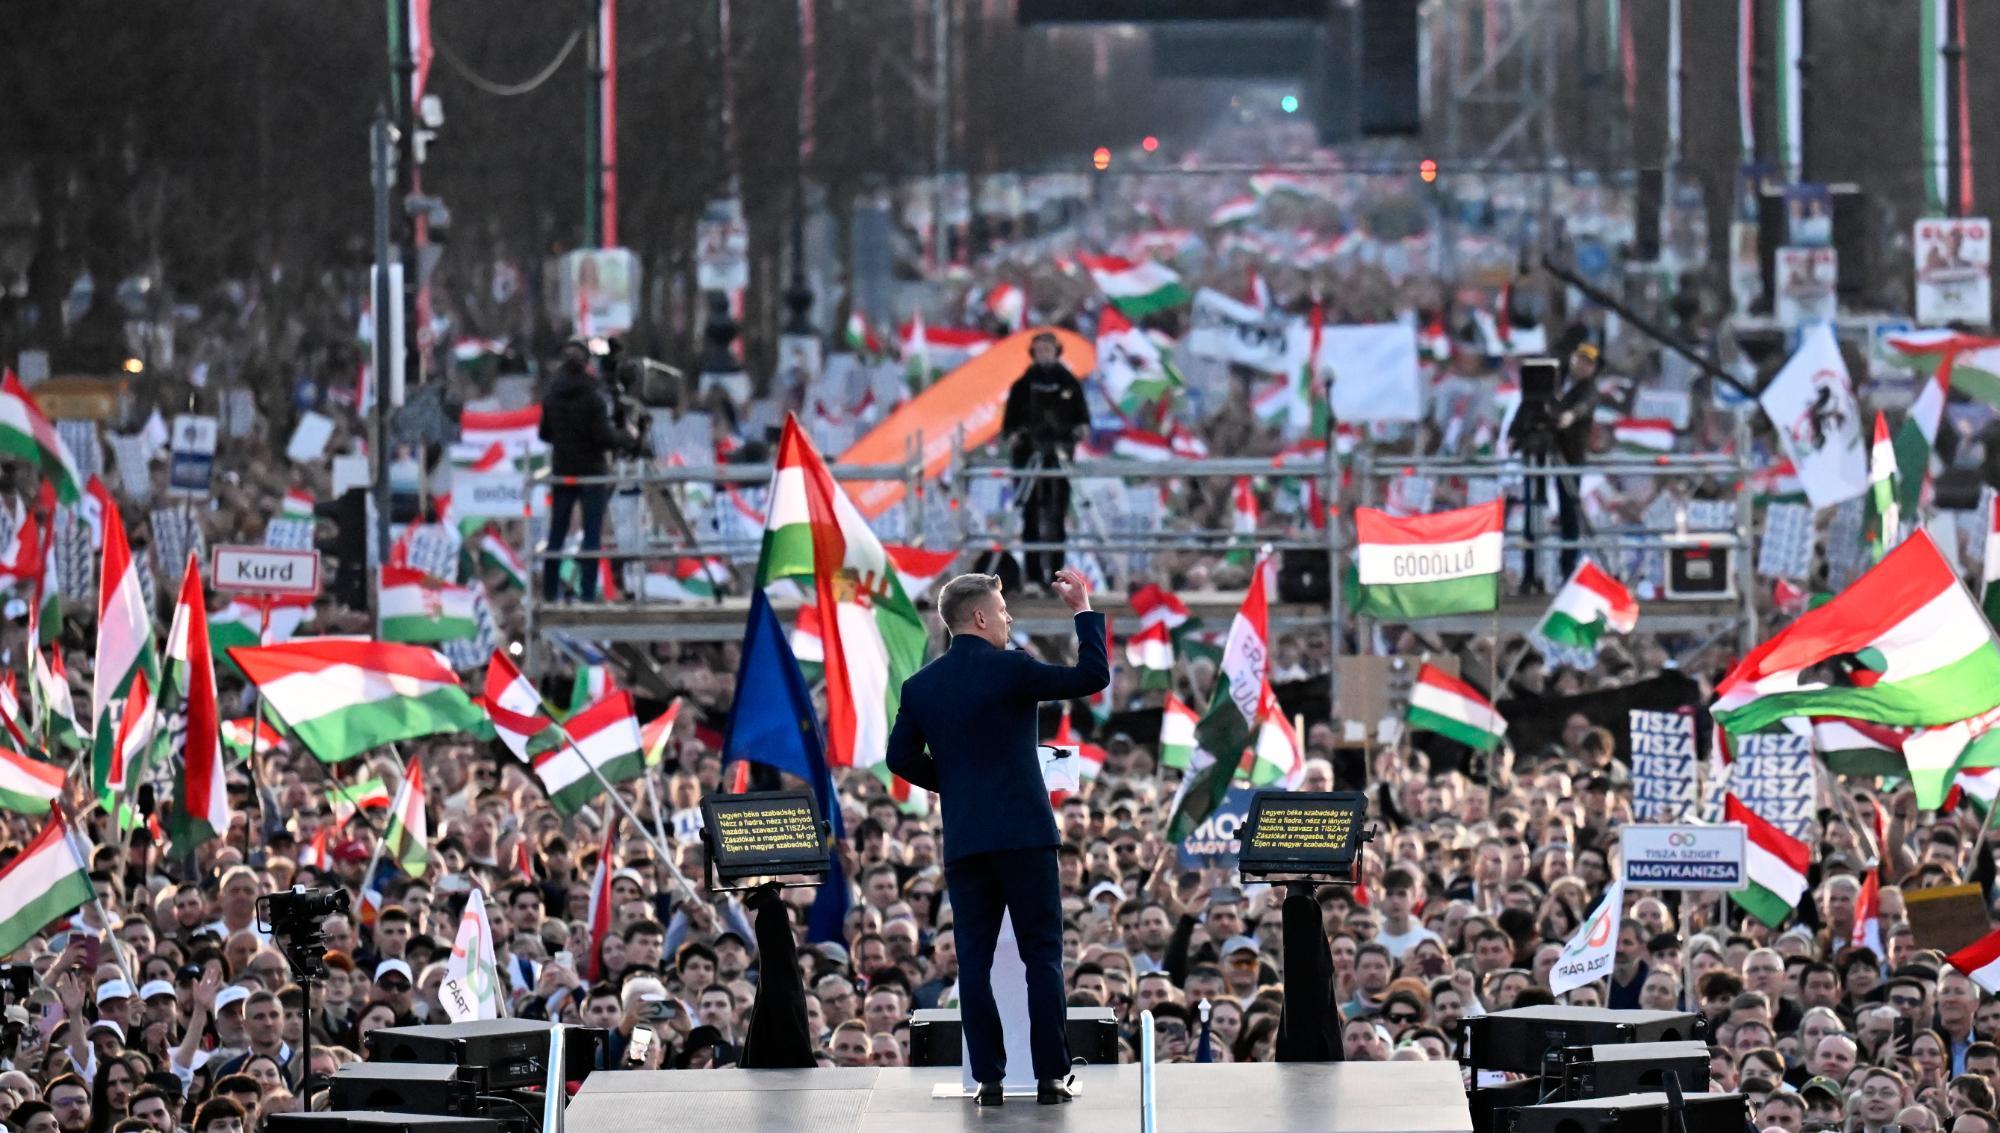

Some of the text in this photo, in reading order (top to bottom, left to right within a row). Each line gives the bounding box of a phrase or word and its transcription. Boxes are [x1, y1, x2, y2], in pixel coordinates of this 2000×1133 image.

[238, 560, 294, 581] Kurd
[1629, 710, 1694, 734] TISZA
[1631, 732, 1695, 755] TISZA
[1737, 734, 1812, 754] TISZA
[1632, 755, 1697, 777] TISZA
[1740, 756, 1815, 776] TISZA
[1633, 777, 1697, 799] TISZA
[1741, 778, 1816, 798] TISZA
[718, 812, 742, 820] Legyen
[1303, 809, 1339, 817] szabadság
[1645, 850, 1720, 859] TISZA SZIGET
[1629, 864, 1737, 879] NAGYKANIZSA
[446, 979, 471, 1015] PÁRT
